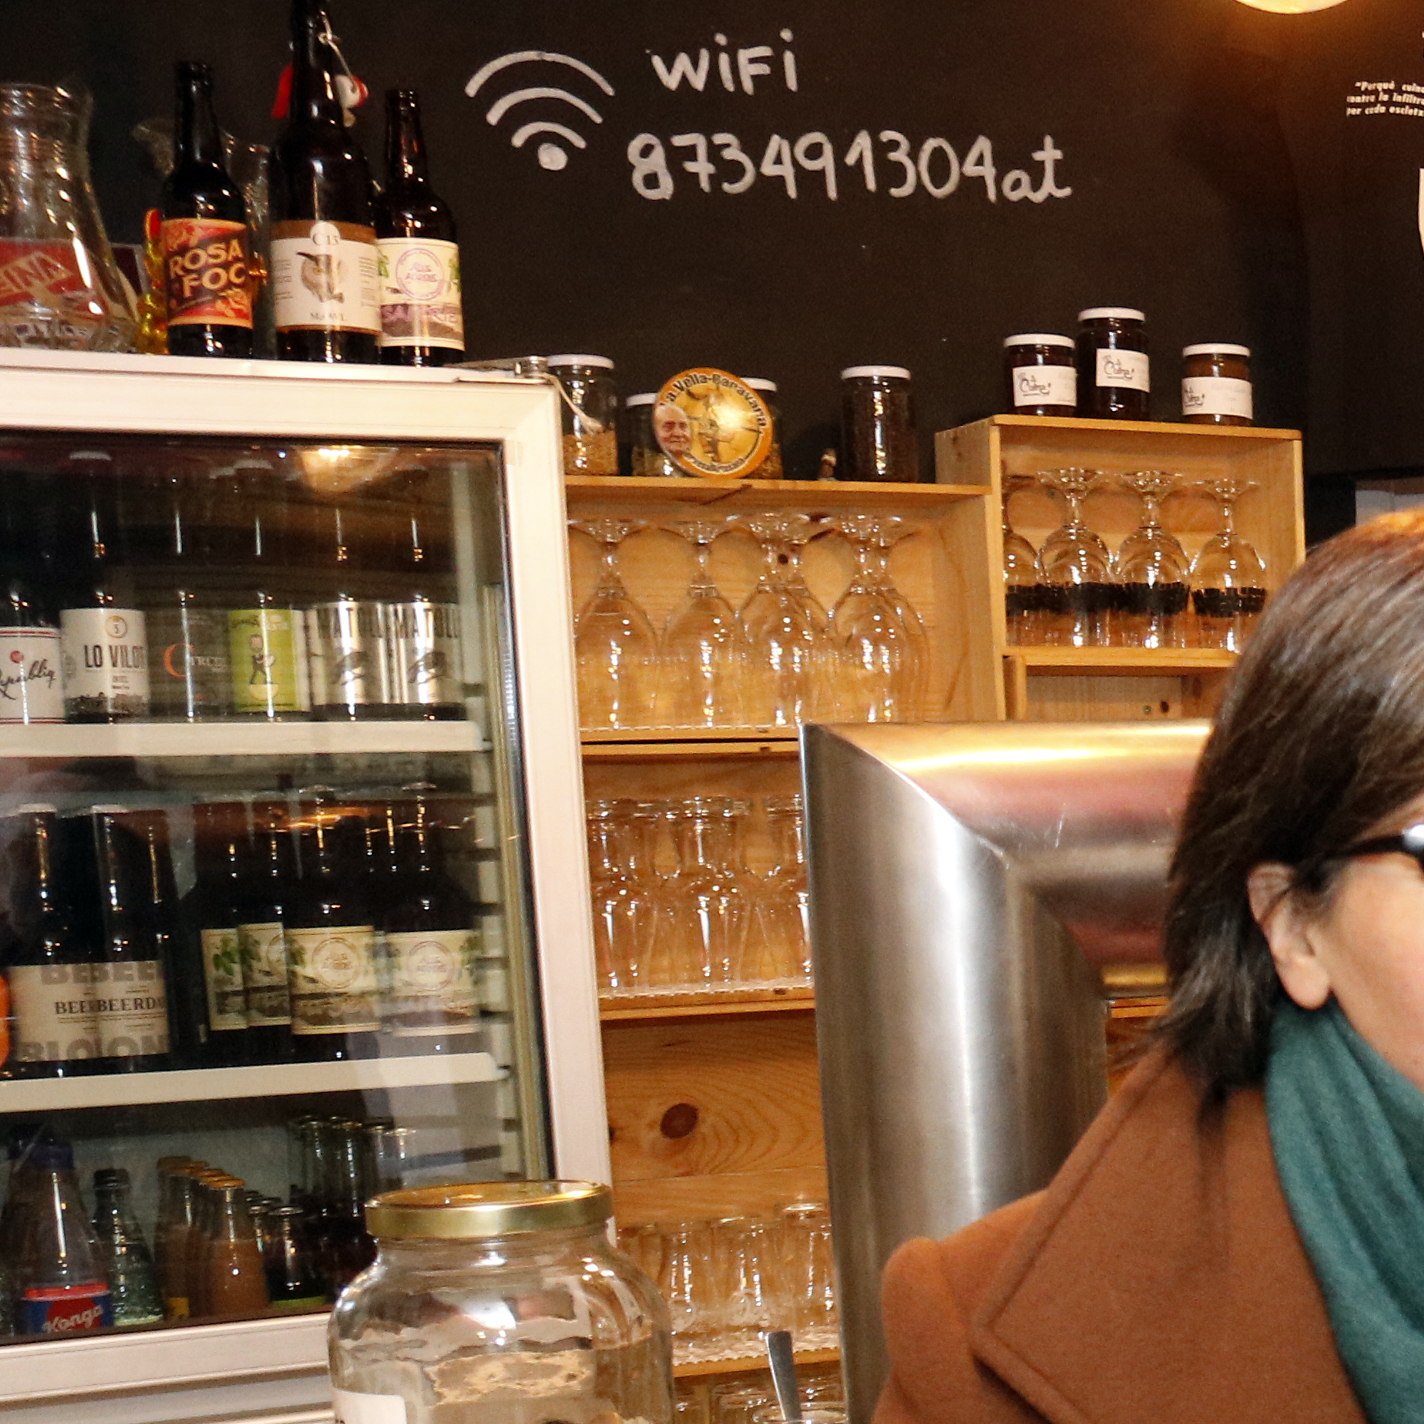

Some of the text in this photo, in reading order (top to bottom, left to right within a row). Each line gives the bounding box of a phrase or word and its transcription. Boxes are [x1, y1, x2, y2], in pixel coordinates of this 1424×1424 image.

[626, 129, 1072, 203] 873491304at
[169, 239, 244, 278] ROSA
[183, 262, 246, 298] FOC
[84, 644, 103, 668] LO
